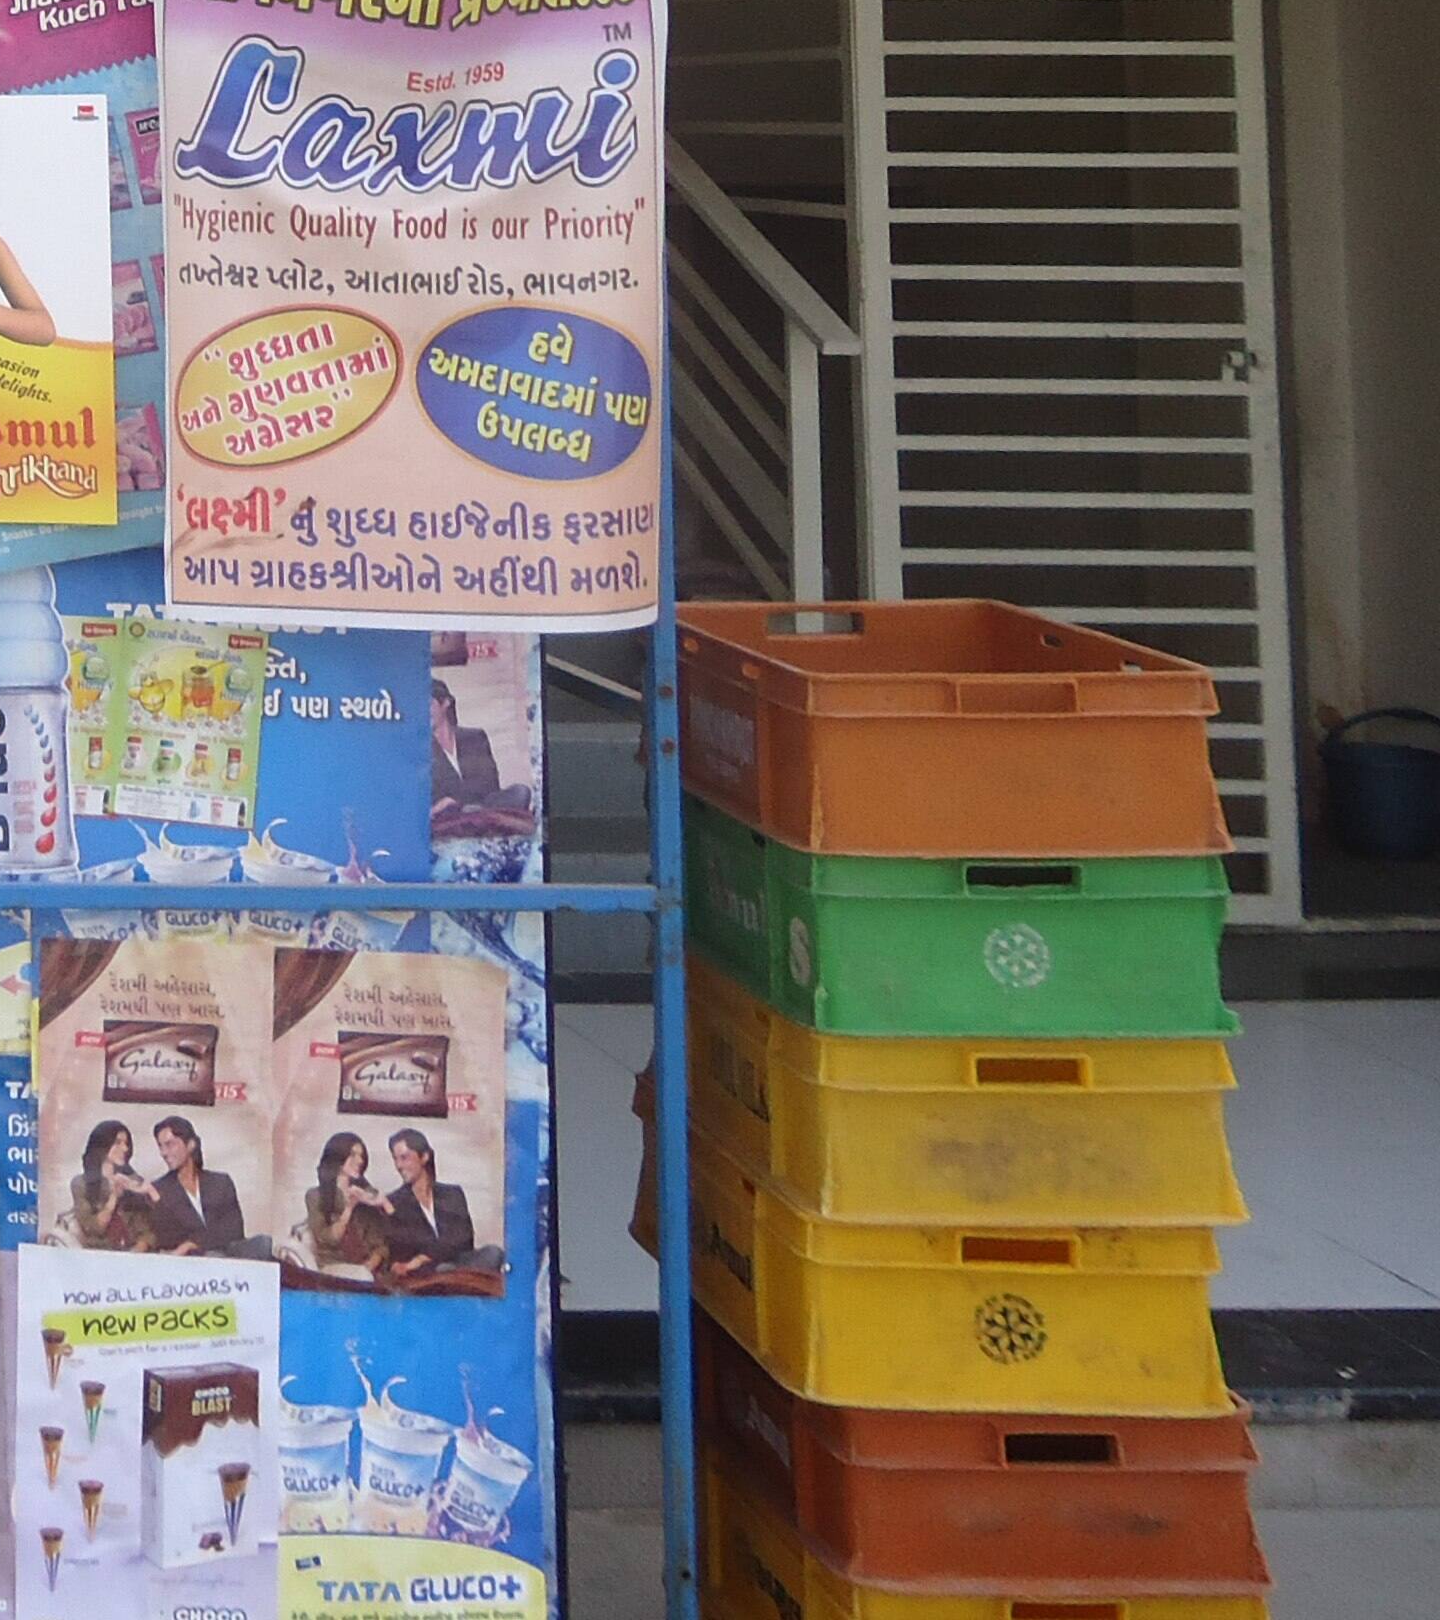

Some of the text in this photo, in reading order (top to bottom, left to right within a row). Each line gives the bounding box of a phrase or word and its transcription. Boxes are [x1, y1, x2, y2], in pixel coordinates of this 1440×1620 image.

[39, 0, 106, 32] Kuch
[406, 62, 505, 93] Estd. 1959
[174, 34, 640, 196] Laxmi
[173, 198, 645, 249] "Hygienic Quality Food is our Priority"
[524, 269, 639, 296] ભાવનગર.
[528, 323, 574, 364] હવે
[428, 347, 650, 428] અમદાવાદમાં પણ
[182, 396, 222, 432] અને
[408, 501, 552, 542] હાઈજેનીક
[563, 501, 654, 545] ફરસાણ
[183, 554, 239, 588] આપ
[292, 696, 328, 718] પણ
[120, 1048, 197, 1081] Galaxy
[355, 1062, 432, 1094] Galaxy
[64, 1291, 101, 1305] now
[83, 1315, 136, 1336] new
[192, 1398, 232, 1416] BLAST
[317, 1575, 521, 1603] TATA GLUCO+
